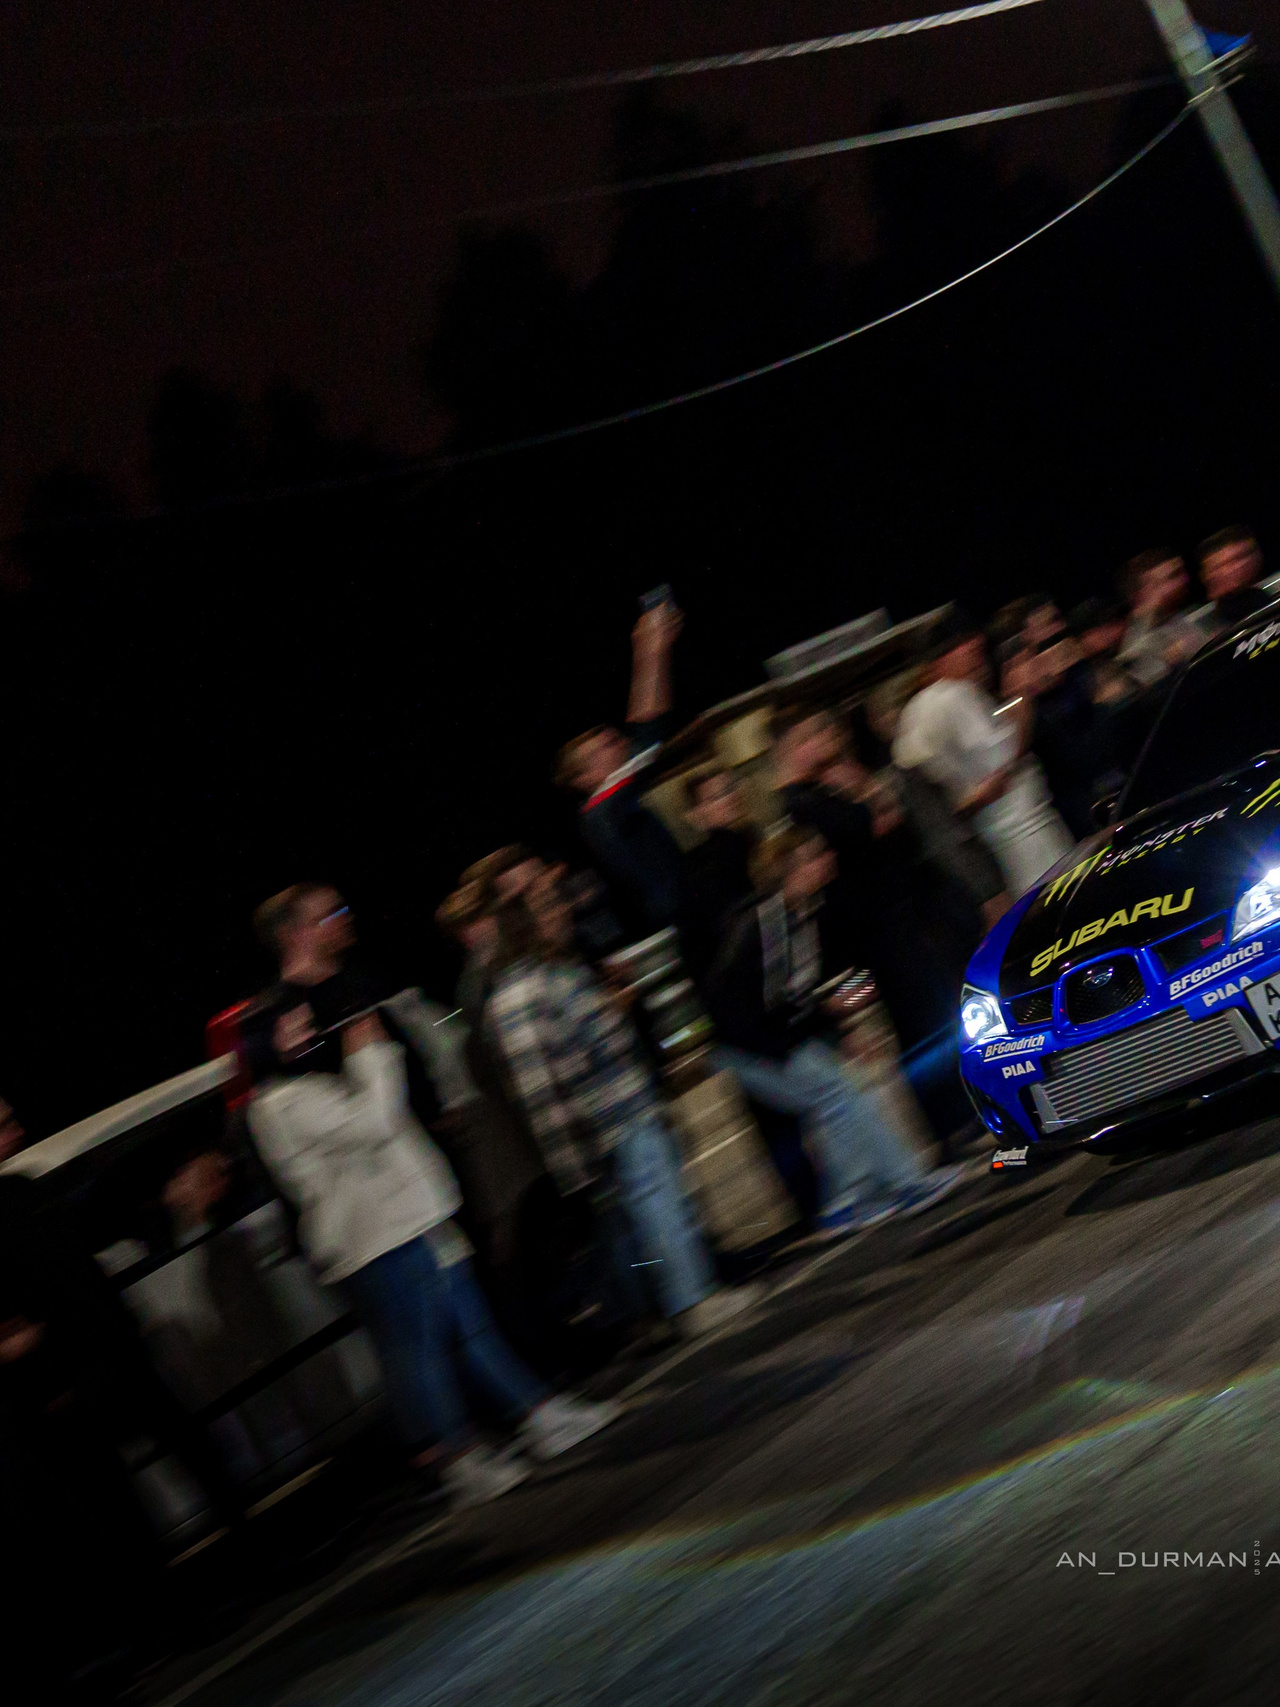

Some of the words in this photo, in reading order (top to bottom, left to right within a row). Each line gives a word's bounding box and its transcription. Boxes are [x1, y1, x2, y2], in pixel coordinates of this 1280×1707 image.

[1030, 887, 1195, 977] SUBARU
[1169, 940, 1264, 996] BFGoodrich
[1201, 975, 1254, 1008] PIAA
[985, 1034, 1045, 1058] BFGoodrich
[1001, 1060, 1037, 1079] PIAA
